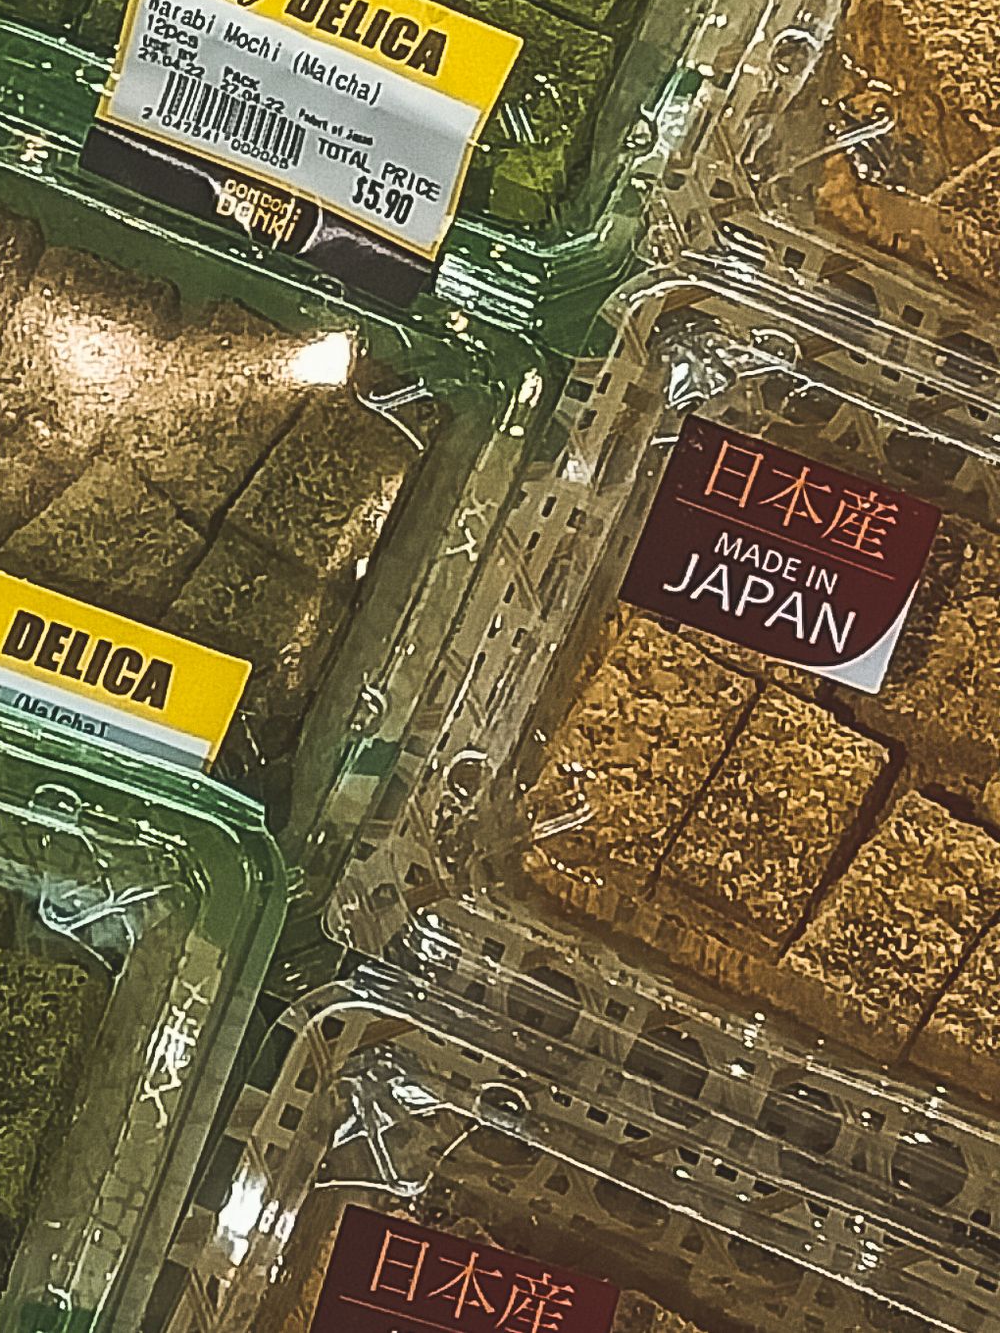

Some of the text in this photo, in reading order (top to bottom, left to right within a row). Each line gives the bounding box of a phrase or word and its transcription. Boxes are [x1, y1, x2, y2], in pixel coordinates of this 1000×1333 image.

[147, 14, 199, 49] 12pcs
[223, 22, 282, 62] Mochi
[292, 51, 383, 107] (Matcha)
[220, 79, 285, 114] 27.04.22
[224, 66, 260, 92] PACK
[318, 137, 441, 203] TOTAL PRICE
[352, 176, 414, 225] $5.90
[704, 440, 899, 560] 日本産
[714, 532, 838, 595] MADE IN
[662, 553, 857, 654] JAPAN
[0, 609, 174, 711] DELICA
[370, 1229, 576, 1333] 日本産
